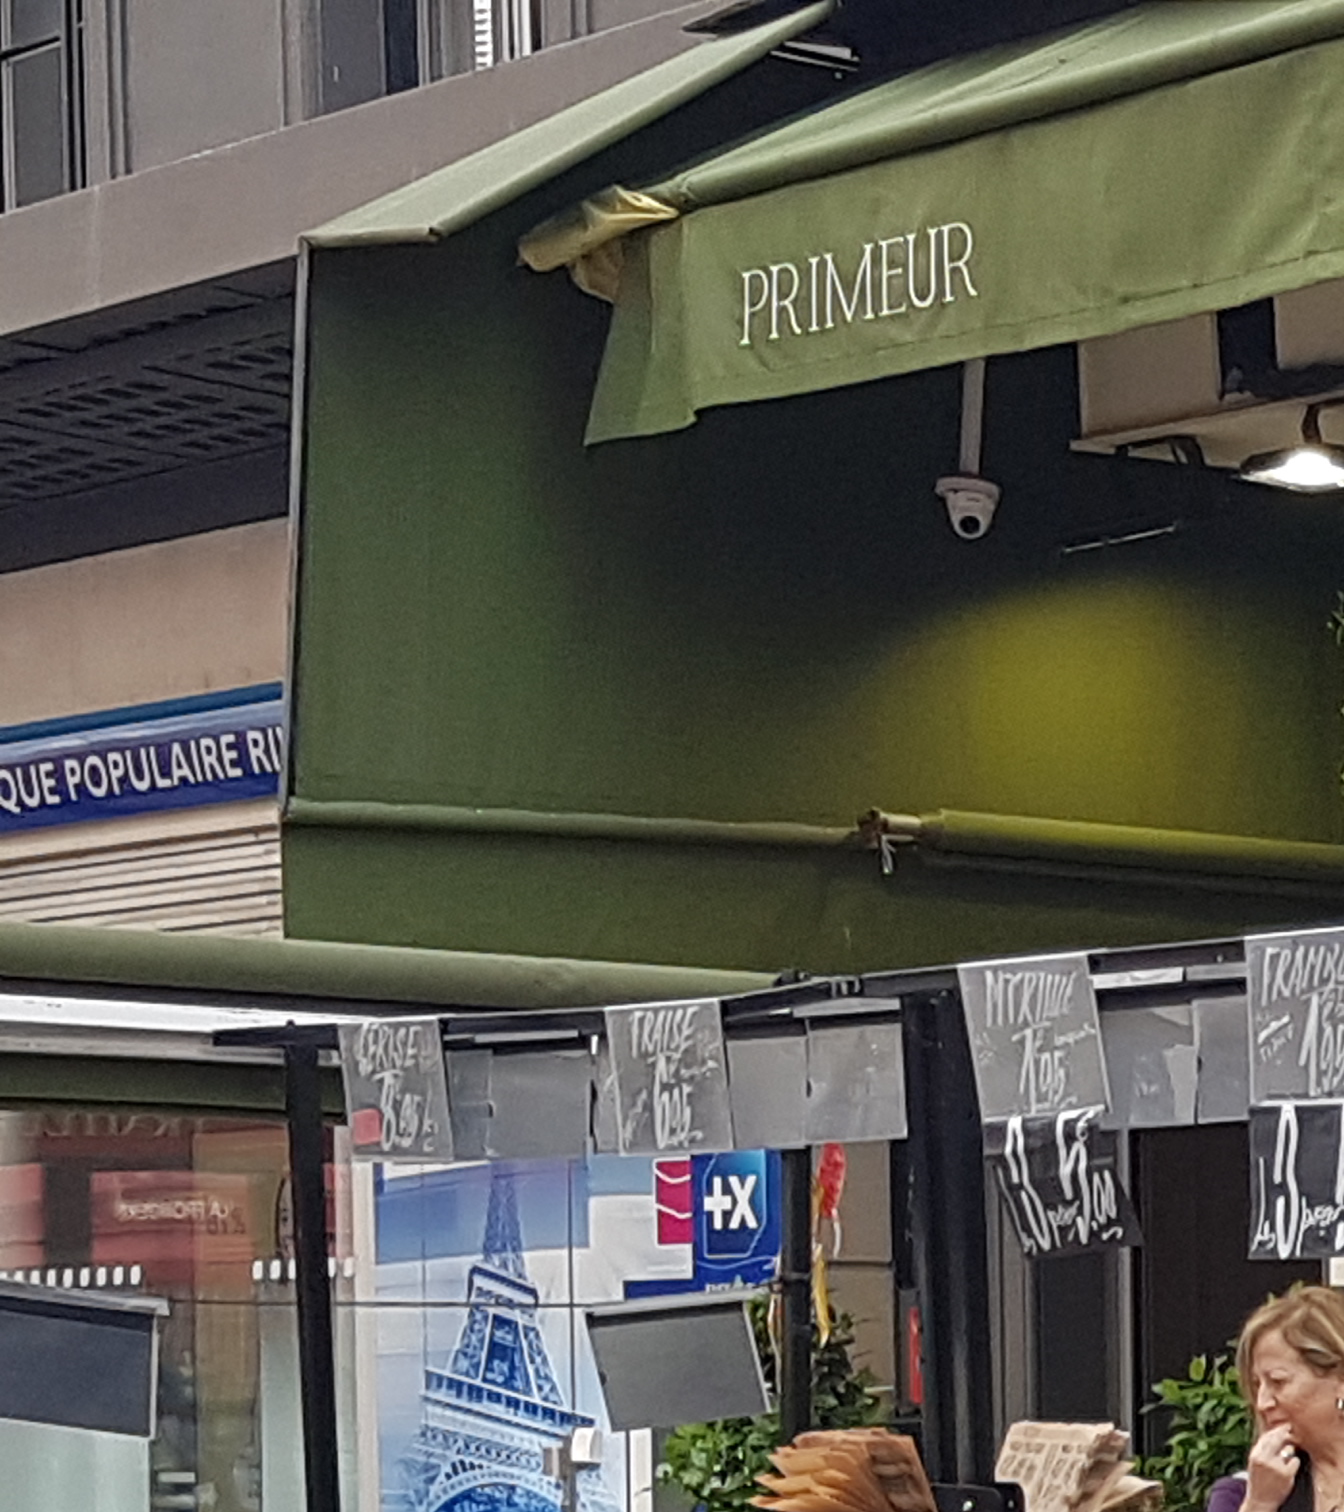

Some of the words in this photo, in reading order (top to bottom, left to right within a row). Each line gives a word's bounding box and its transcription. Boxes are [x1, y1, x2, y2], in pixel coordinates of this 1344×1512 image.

[739, 221, 978, 346] PRIMEUR
[64, 732, 243, 802] POPULAIRE
[703, 1173, 759, 1231] +X
[1004, 1115, 1052, 1252] 3
[1273, 1102, 1300, 1260] 3
